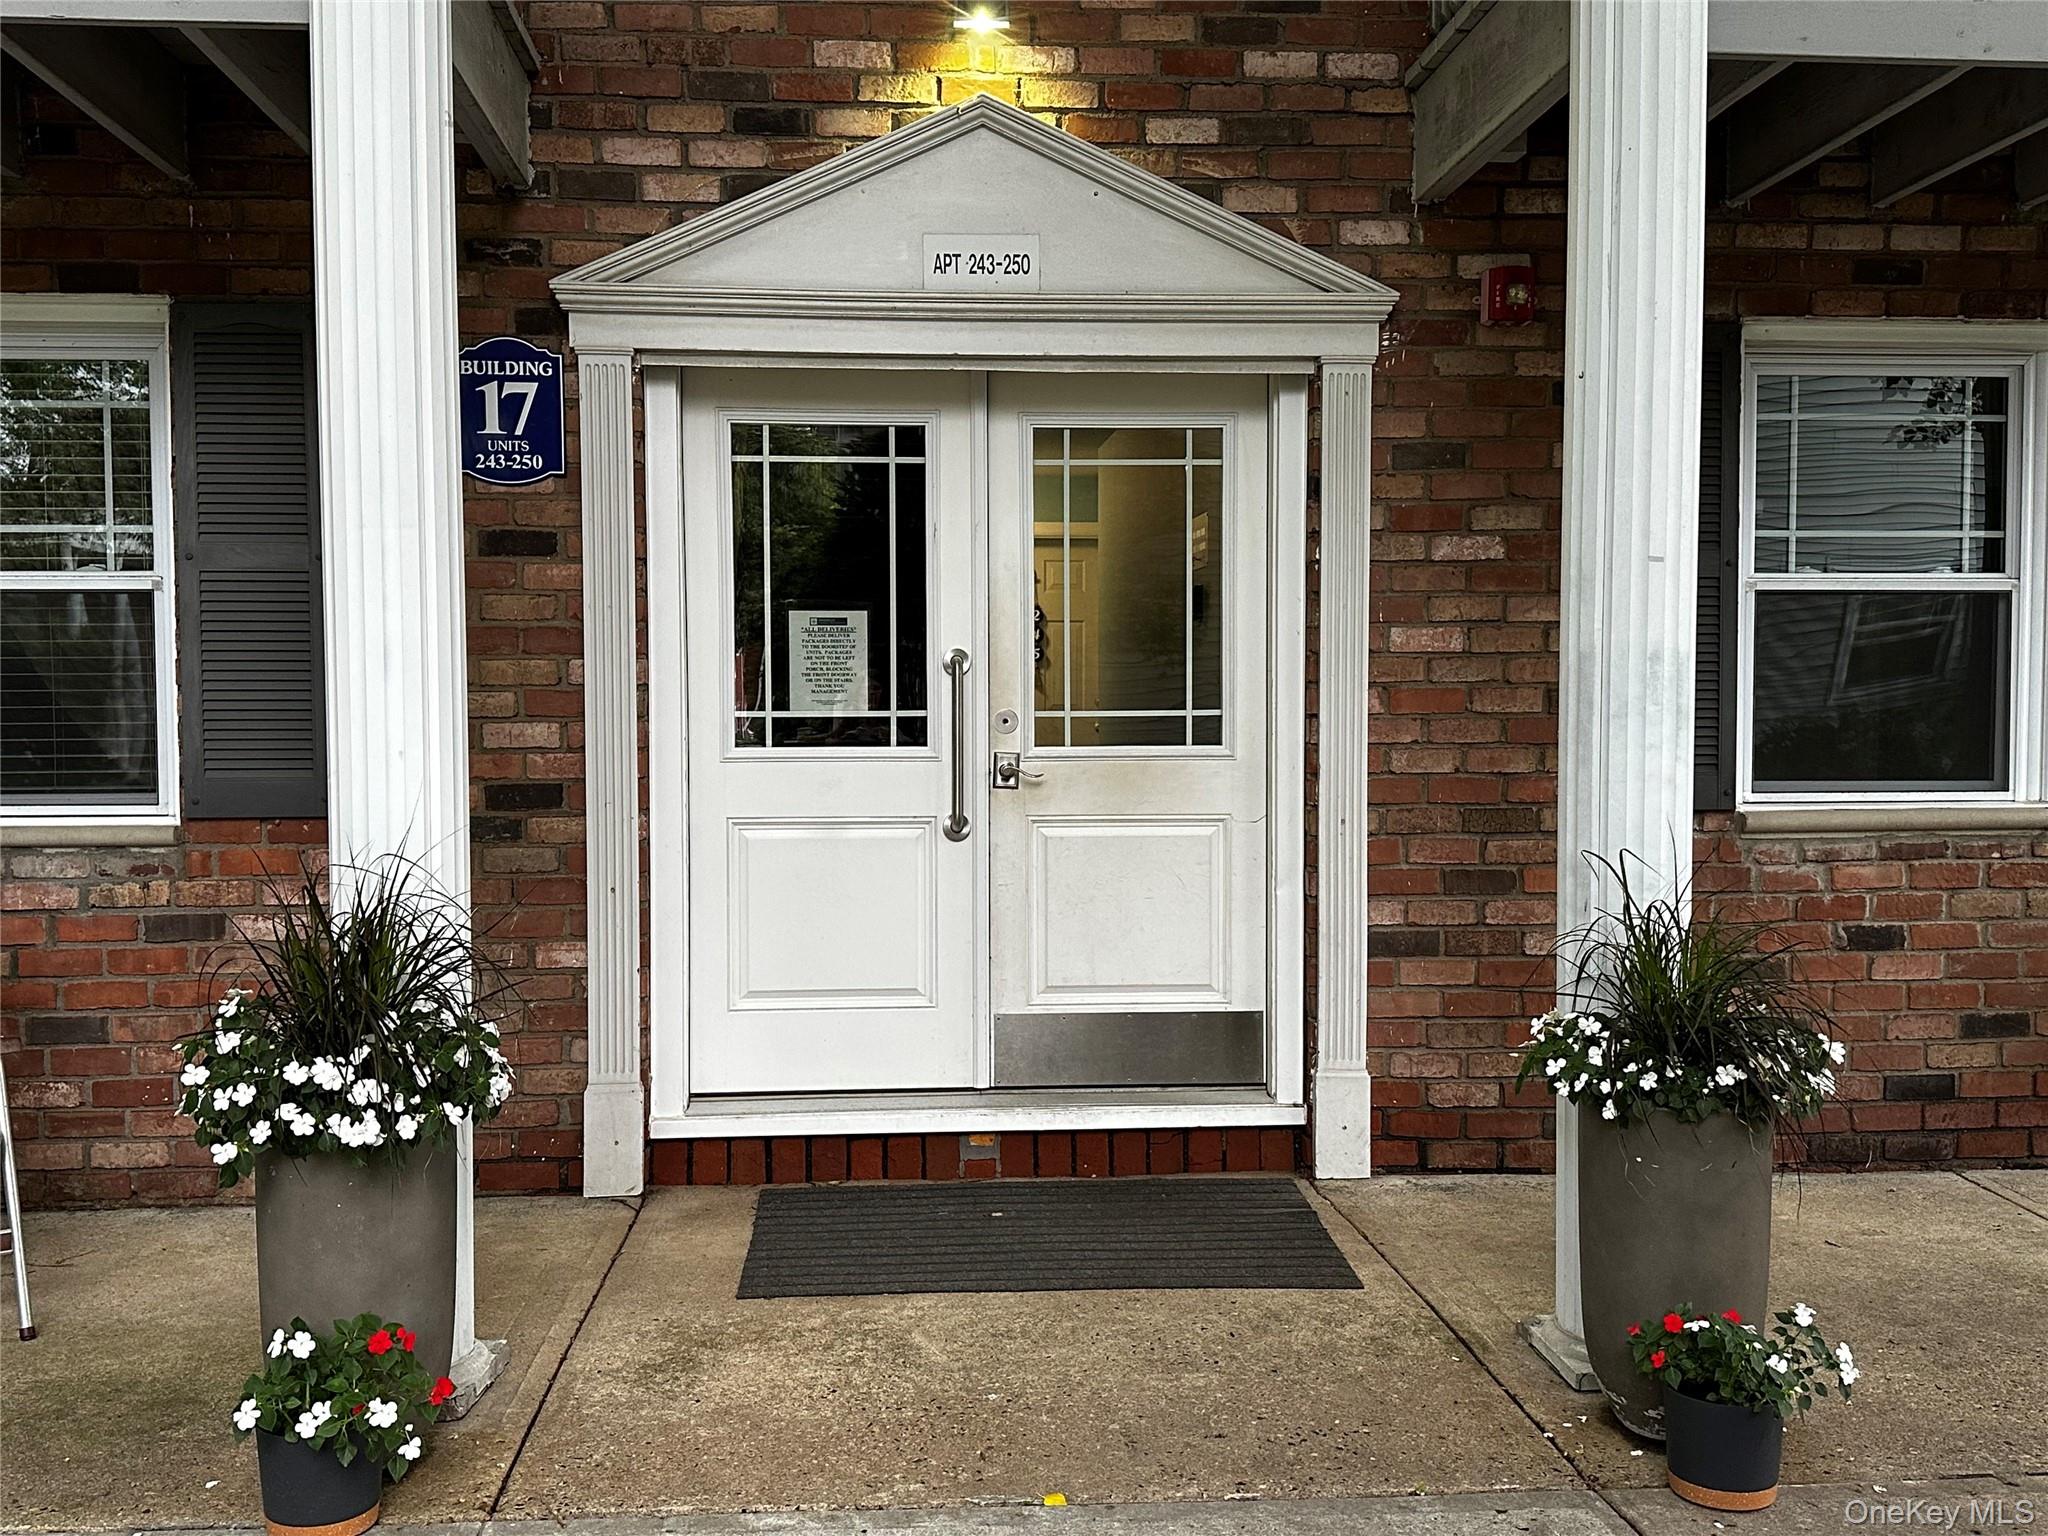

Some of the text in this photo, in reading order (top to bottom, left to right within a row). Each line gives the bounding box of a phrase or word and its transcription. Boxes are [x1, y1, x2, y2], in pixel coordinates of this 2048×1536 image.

[933, 253, 1031, 275] APT 243-250
[460, 360, 553, 376] BUILDING
[475, 380, 539, 435] 17
[487, 440, 530, 452] UNITS
[475, 454, 543, 470] 243-250
